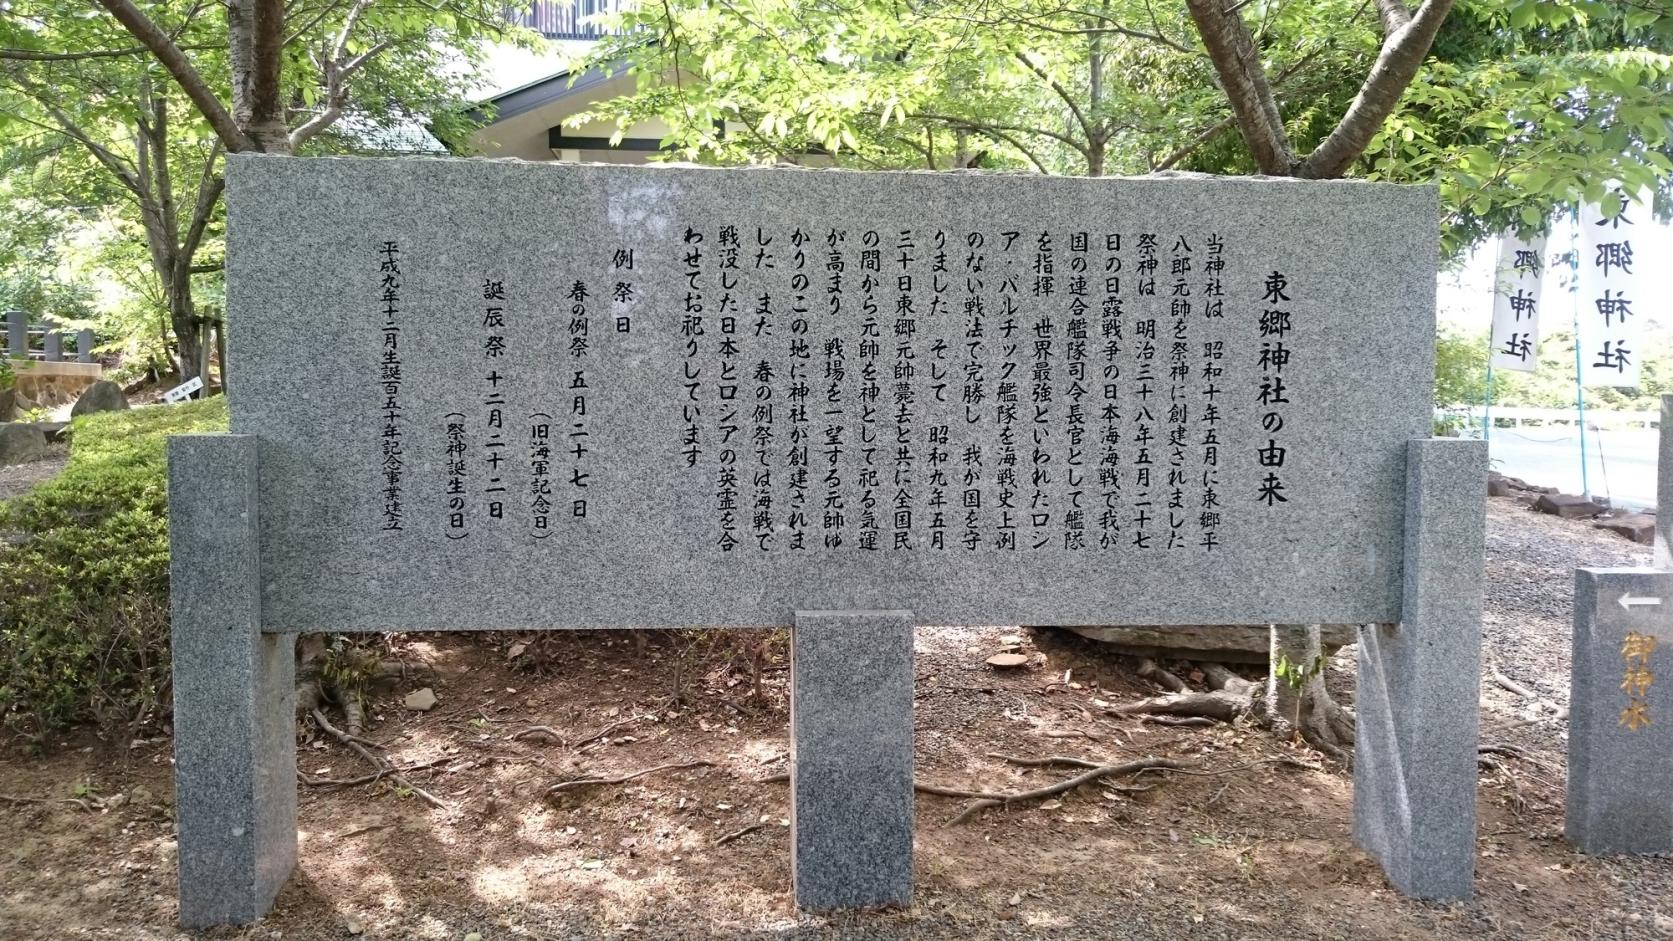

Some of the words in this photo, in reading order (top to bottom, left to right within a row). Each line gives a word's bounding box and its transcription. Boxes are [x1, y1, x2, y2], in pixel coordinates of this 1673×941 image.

[379, 241, 403, 530] 平成九年十二月生誕百五十年記念事業建立
[612, 249, 633, 333] 例祭日
[681, 226, 704, 467] わせてお祀りしています
[717, 225, 740, 552] 戦没した日本とロシアの英霊を合
[787, 228, 810, 550] かりのこの地に神社が創建されま
[858, 231, 881, 551] の間から元帥を神として祀る気運
[893, 230, 916, 550] 三十日東郷元帥薨去と共に全国民
[995, 231, 1020, 551] ア・バルチック艦隊を海戦史上例
[1064, 232, 1088, 550] 国の連合艦隊司令長官として艦隊
[1099, 234, 1123, 549] 日の日露戦争の日本海海戦で我が
[1168, 235, 1192, 549] 八郎元帥を祭神に創建されました
[1256, 271, 1291, 506] 東郷神社の由来
[1618, 631, 1658, 732] 御神水
